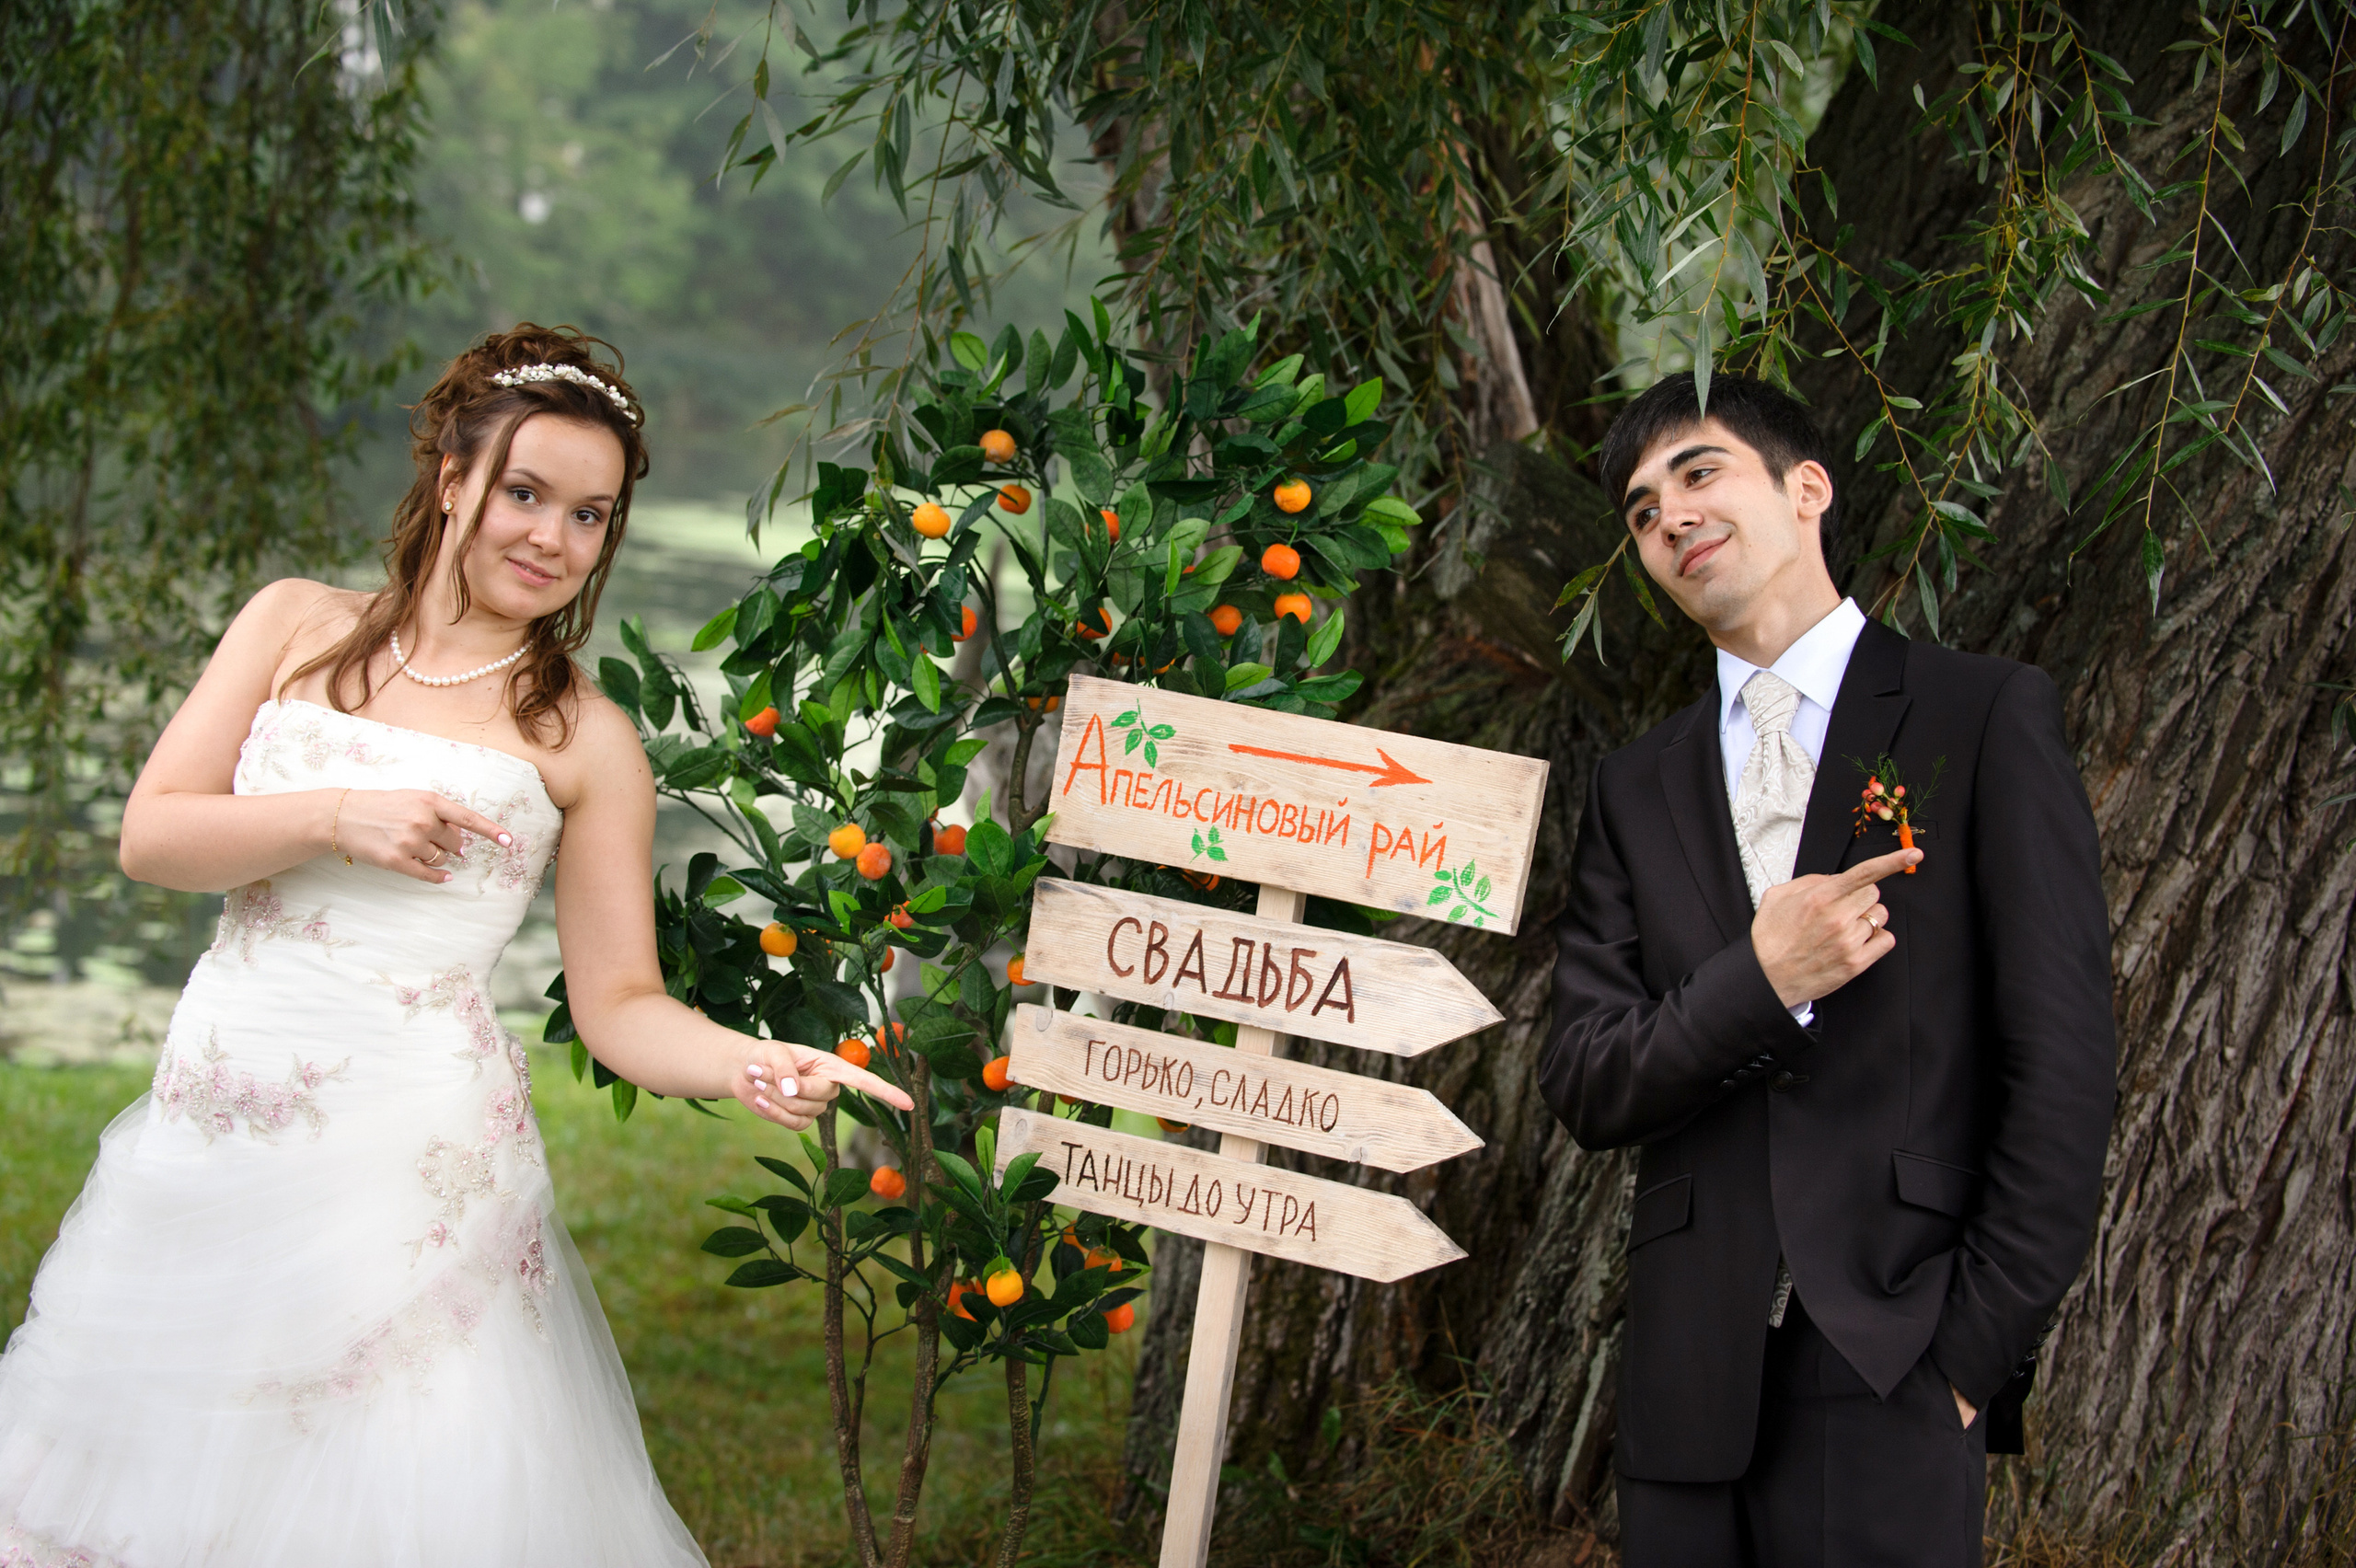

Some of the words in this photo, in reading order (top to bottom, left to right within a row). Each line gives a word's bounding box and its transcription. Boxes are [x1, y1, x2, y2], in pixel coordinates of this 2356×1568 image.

[1107, 917, 1355, 1023] СВАДЬБА
[1062, 1142, 1174, 1207] ТАНЦЫ
[1178, 1174, 1223, 1216] ДО
[1234, 1184, 1318, 1240] УТРА
